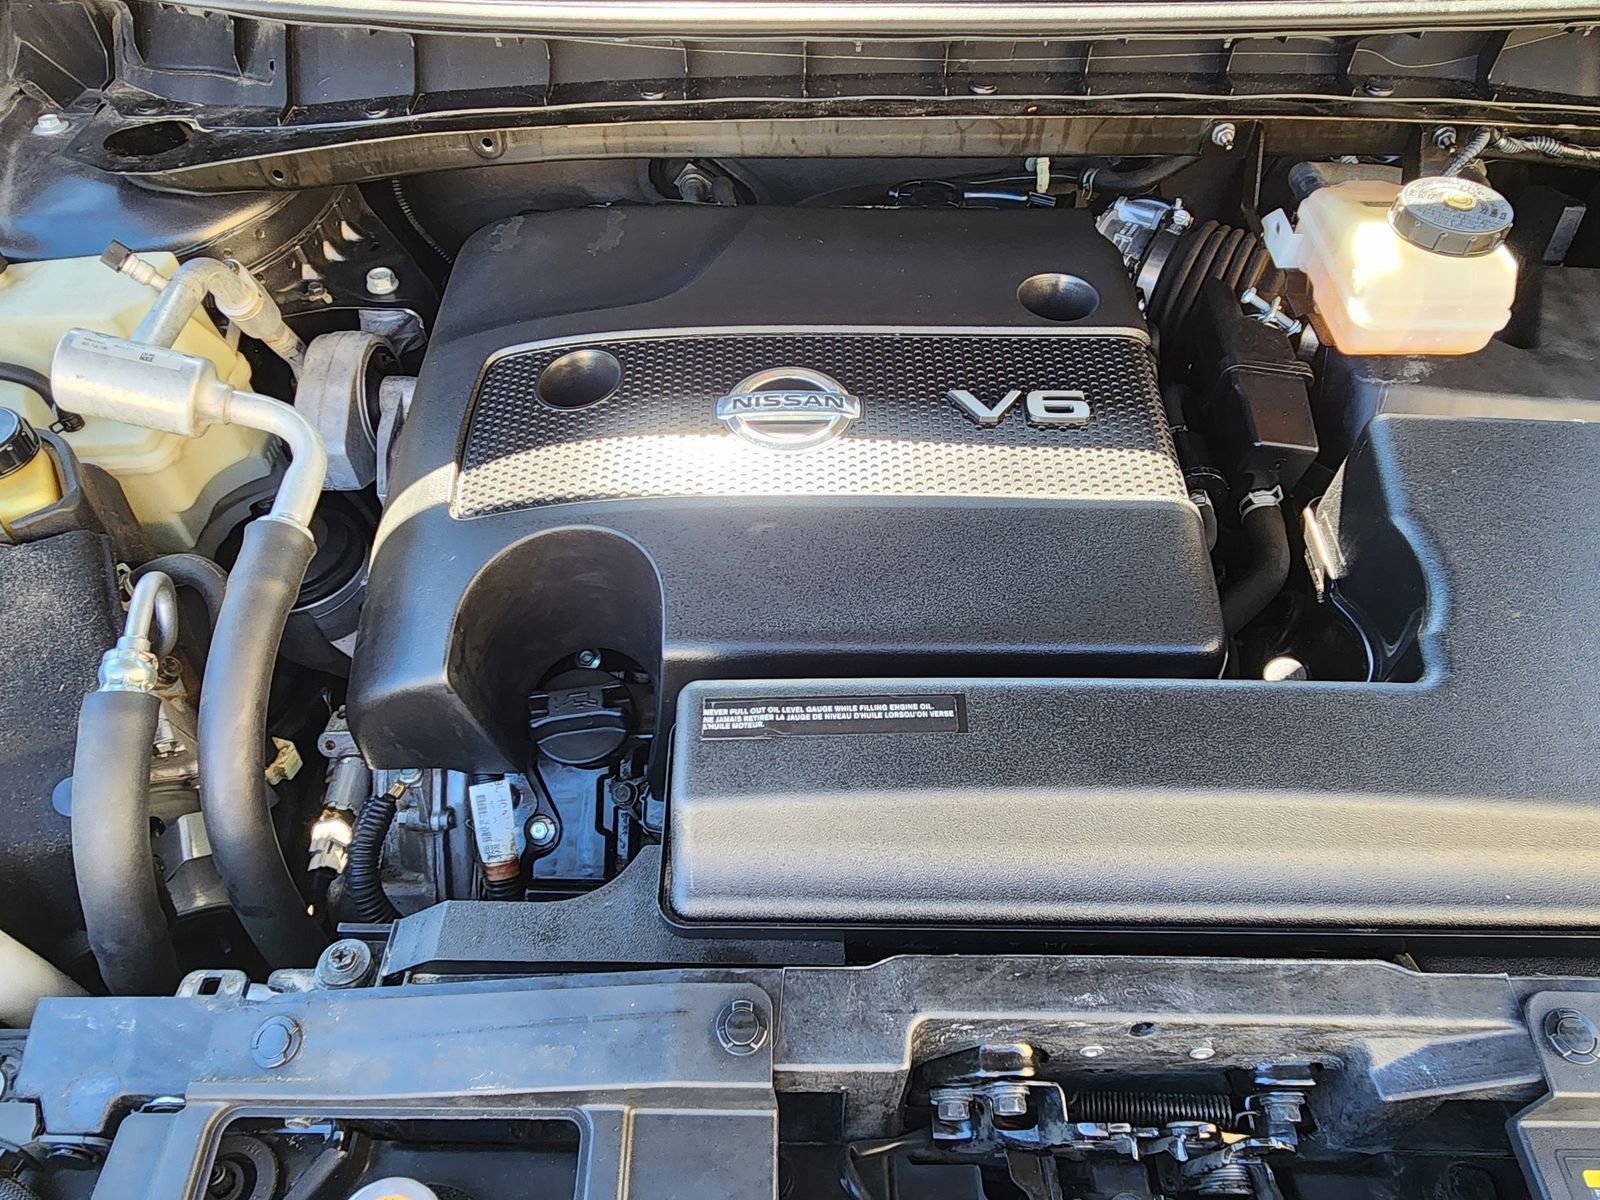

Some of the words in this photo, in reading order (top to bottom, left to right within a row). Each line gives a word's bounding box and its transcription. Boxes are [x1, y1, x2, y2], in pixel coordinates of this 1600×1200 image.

[732, 395, 845, 410] NISSAN
[949, 388, 1093, 427] V6
[703, 708, 728, 716] NEVER
[729, 708, 749, 716] PULL
[750, 707, 766, 715] OUT
[767, 706, 780, 714] OIL
[781, 706, 804, 714] LEVEL
[805, 705, 833, 713] GAUGE
[834, 704, 858, 713] WHILE
[859, 704, 888, 712] FILLING
[889, 703, 919, 712] ENGINE
[919, 703, 935, 711] OIL.
[715, 715, 742, 723] JAMAIS
[787, 713, 811, 721] JAUGE
[825, 712, 853, 720] NIVEAU
[853, 711, 883, 719] D'HUILE
[884, 711, 929, 719] LORSQU'ON
[929, 710, 955, 718] VERSE
